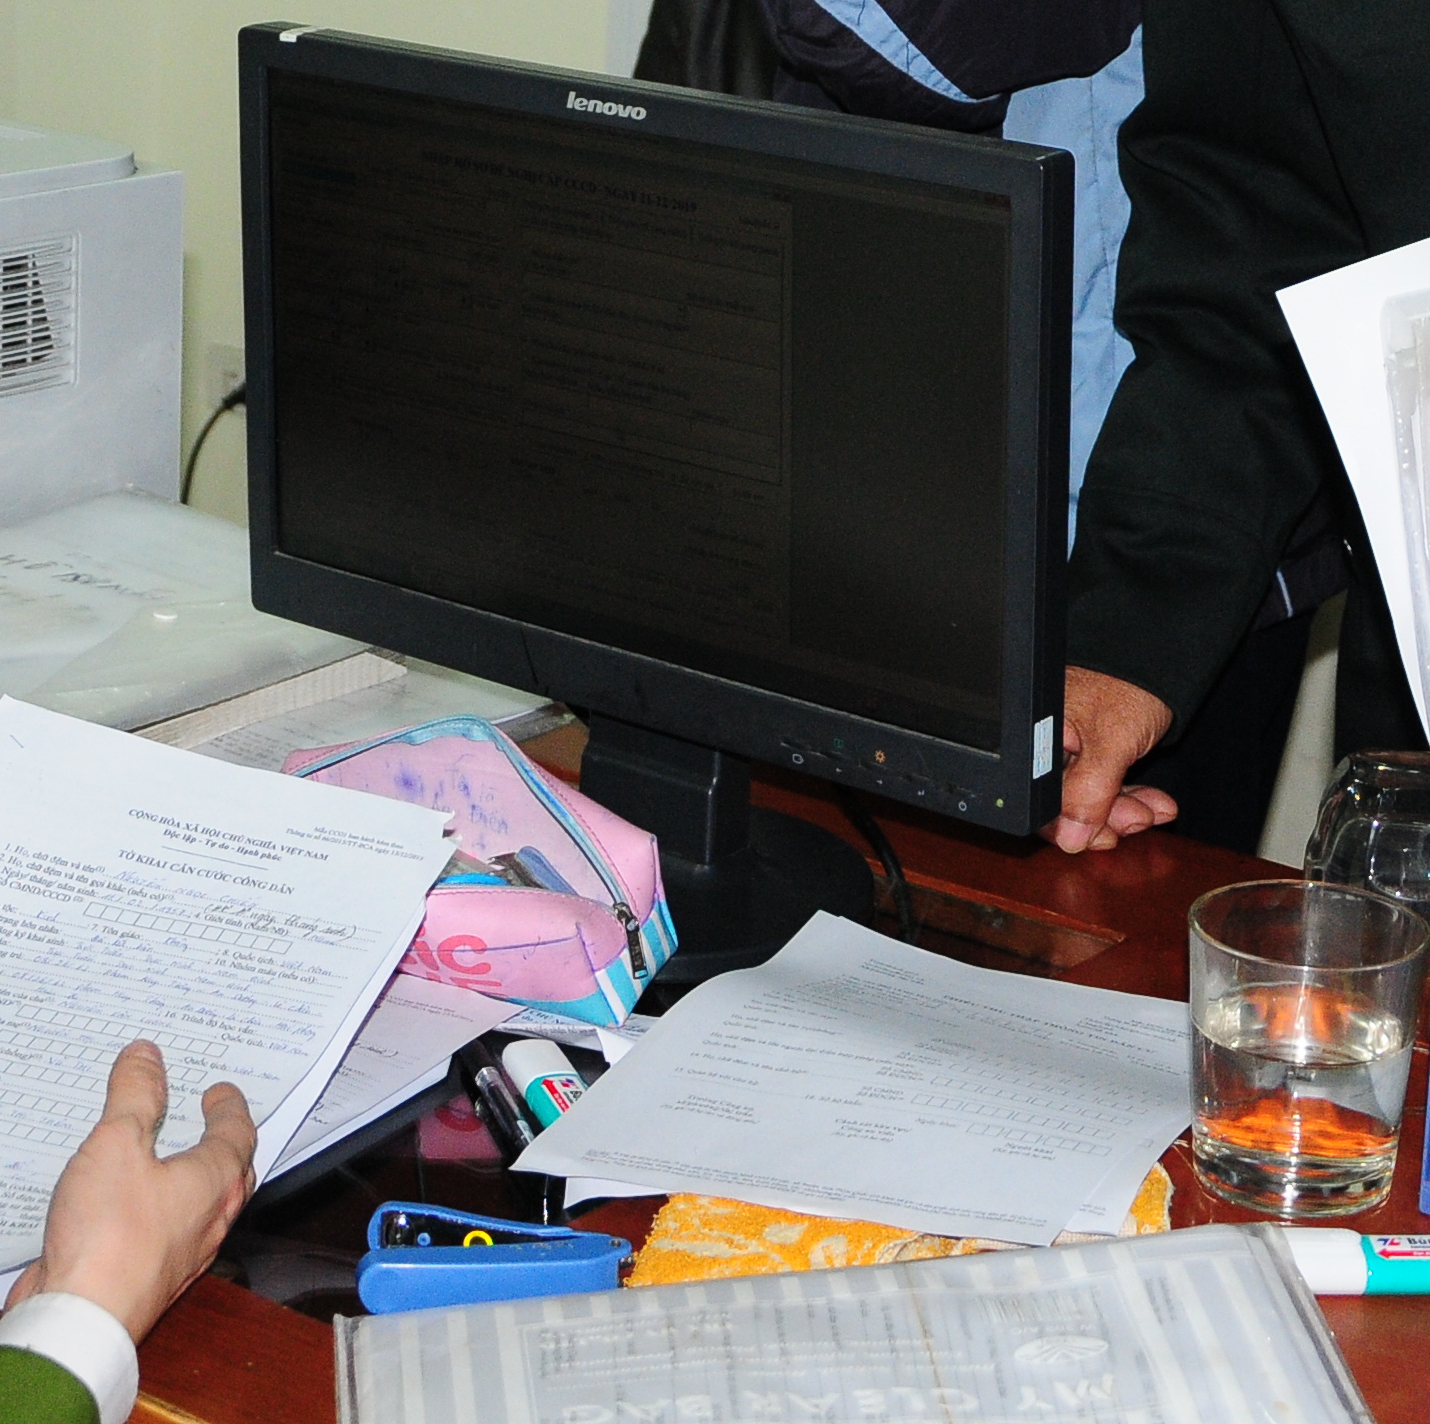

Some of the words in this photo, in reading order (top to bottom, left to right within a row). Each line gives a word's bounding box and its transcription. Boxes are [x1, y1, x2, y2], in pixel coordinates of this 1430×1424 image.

[566, 91, 647, 120] lenovo
[128, 809, 159, 822] CỘNG
[158, 816, 181, 829] HÒA
[182, 823, 200, 833] XÃ
[200, 827, 221, 838] HỘI
[221, 832, 245, 843] CHỦ
[244, 837, 276, 851] NGHĨA
[280, 845, 305, 856] VIỆT
[304, 850, 329, 861] NAM
[163, 828, 181, 839] Độc
[182, 833, 197, 844] lập
[236, 846, 259, 857] Hạnh
[259, 852, 282, 861] phúc
[118, 849, 136, 860] TỜ
[135, 854, 168, 869] KHAI
[169, 863, 196, 875] CĂN
[196, 869, 233, 882] CƯỚC
[232, 876, 268, 890] CÔNG
[268, 883, 295, 895] DÂN
[232, 951, 256, 962] Quốc
